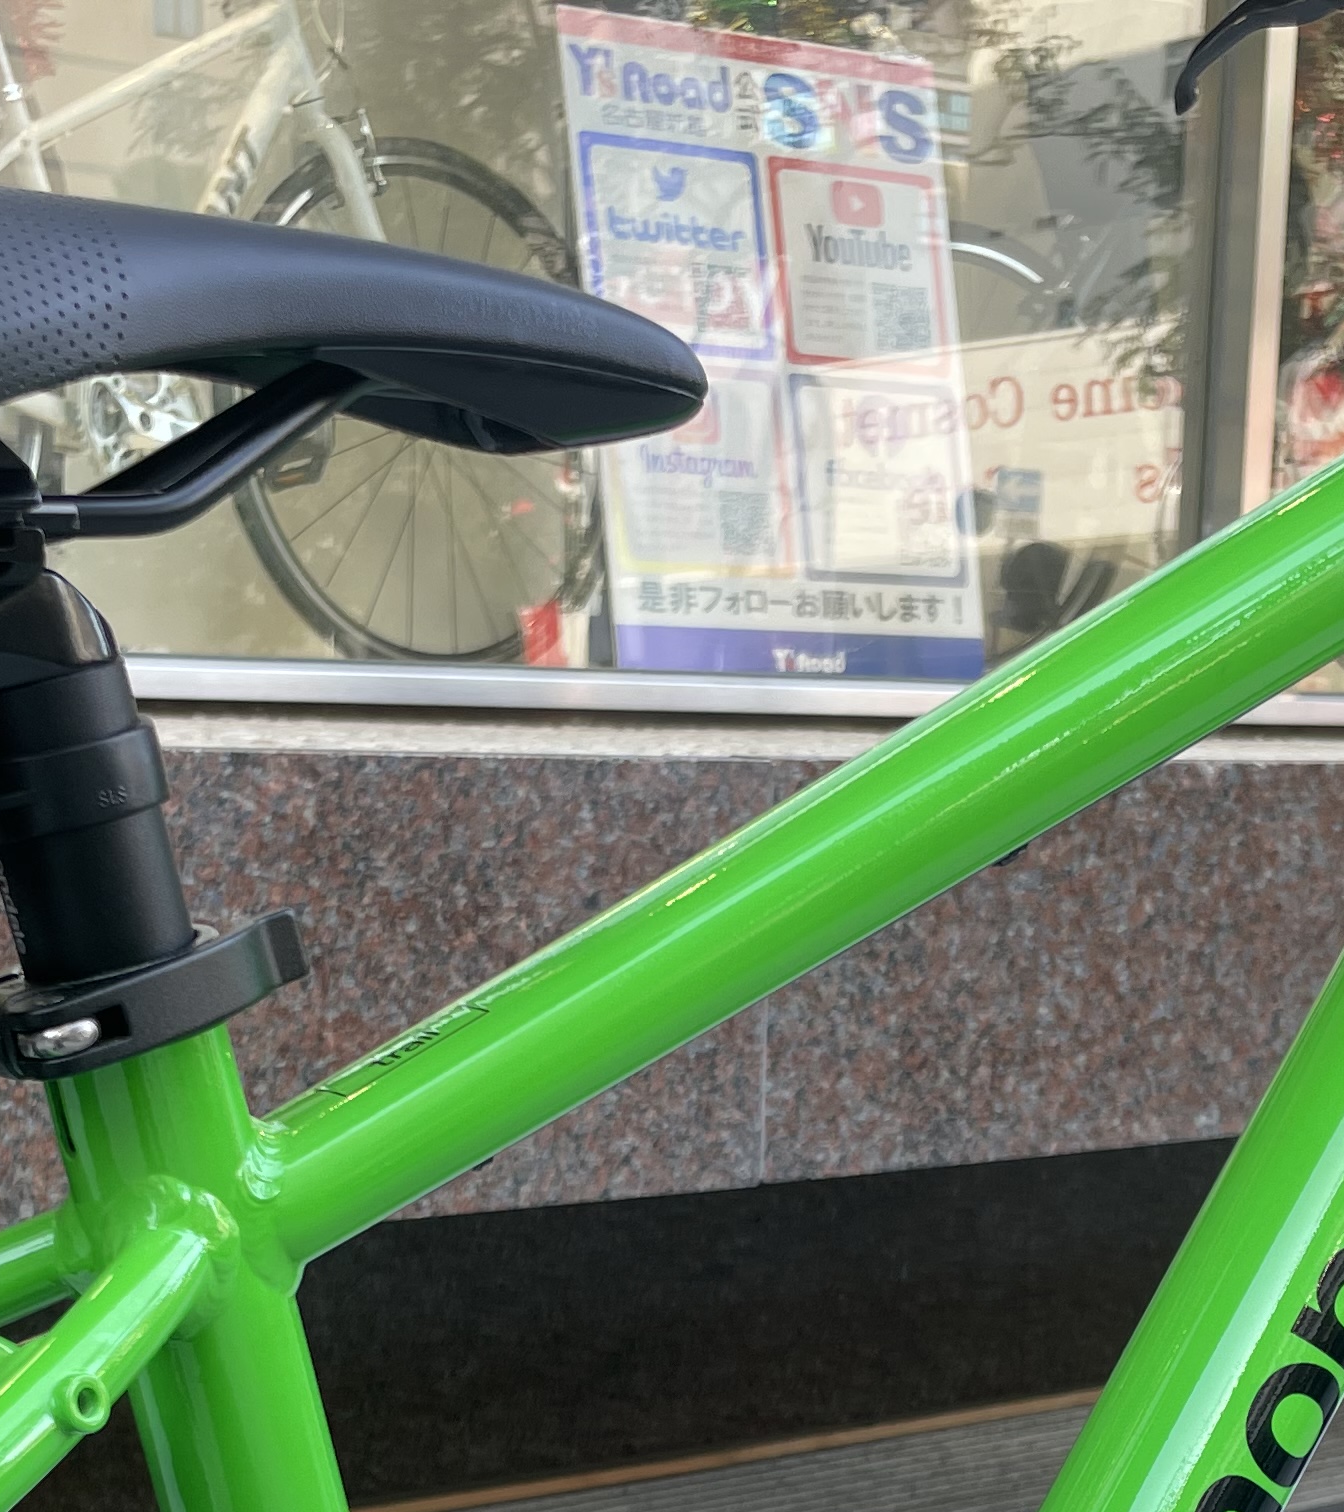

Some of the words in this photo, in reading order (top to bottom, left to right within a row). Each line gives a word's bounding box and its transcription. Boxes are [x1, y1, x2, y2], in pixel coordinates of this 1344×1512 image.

[607, 204, 747, 252] twitter
[804, 222, 913, 272] YouTube
[640, 443, 757, 489] Instagram
